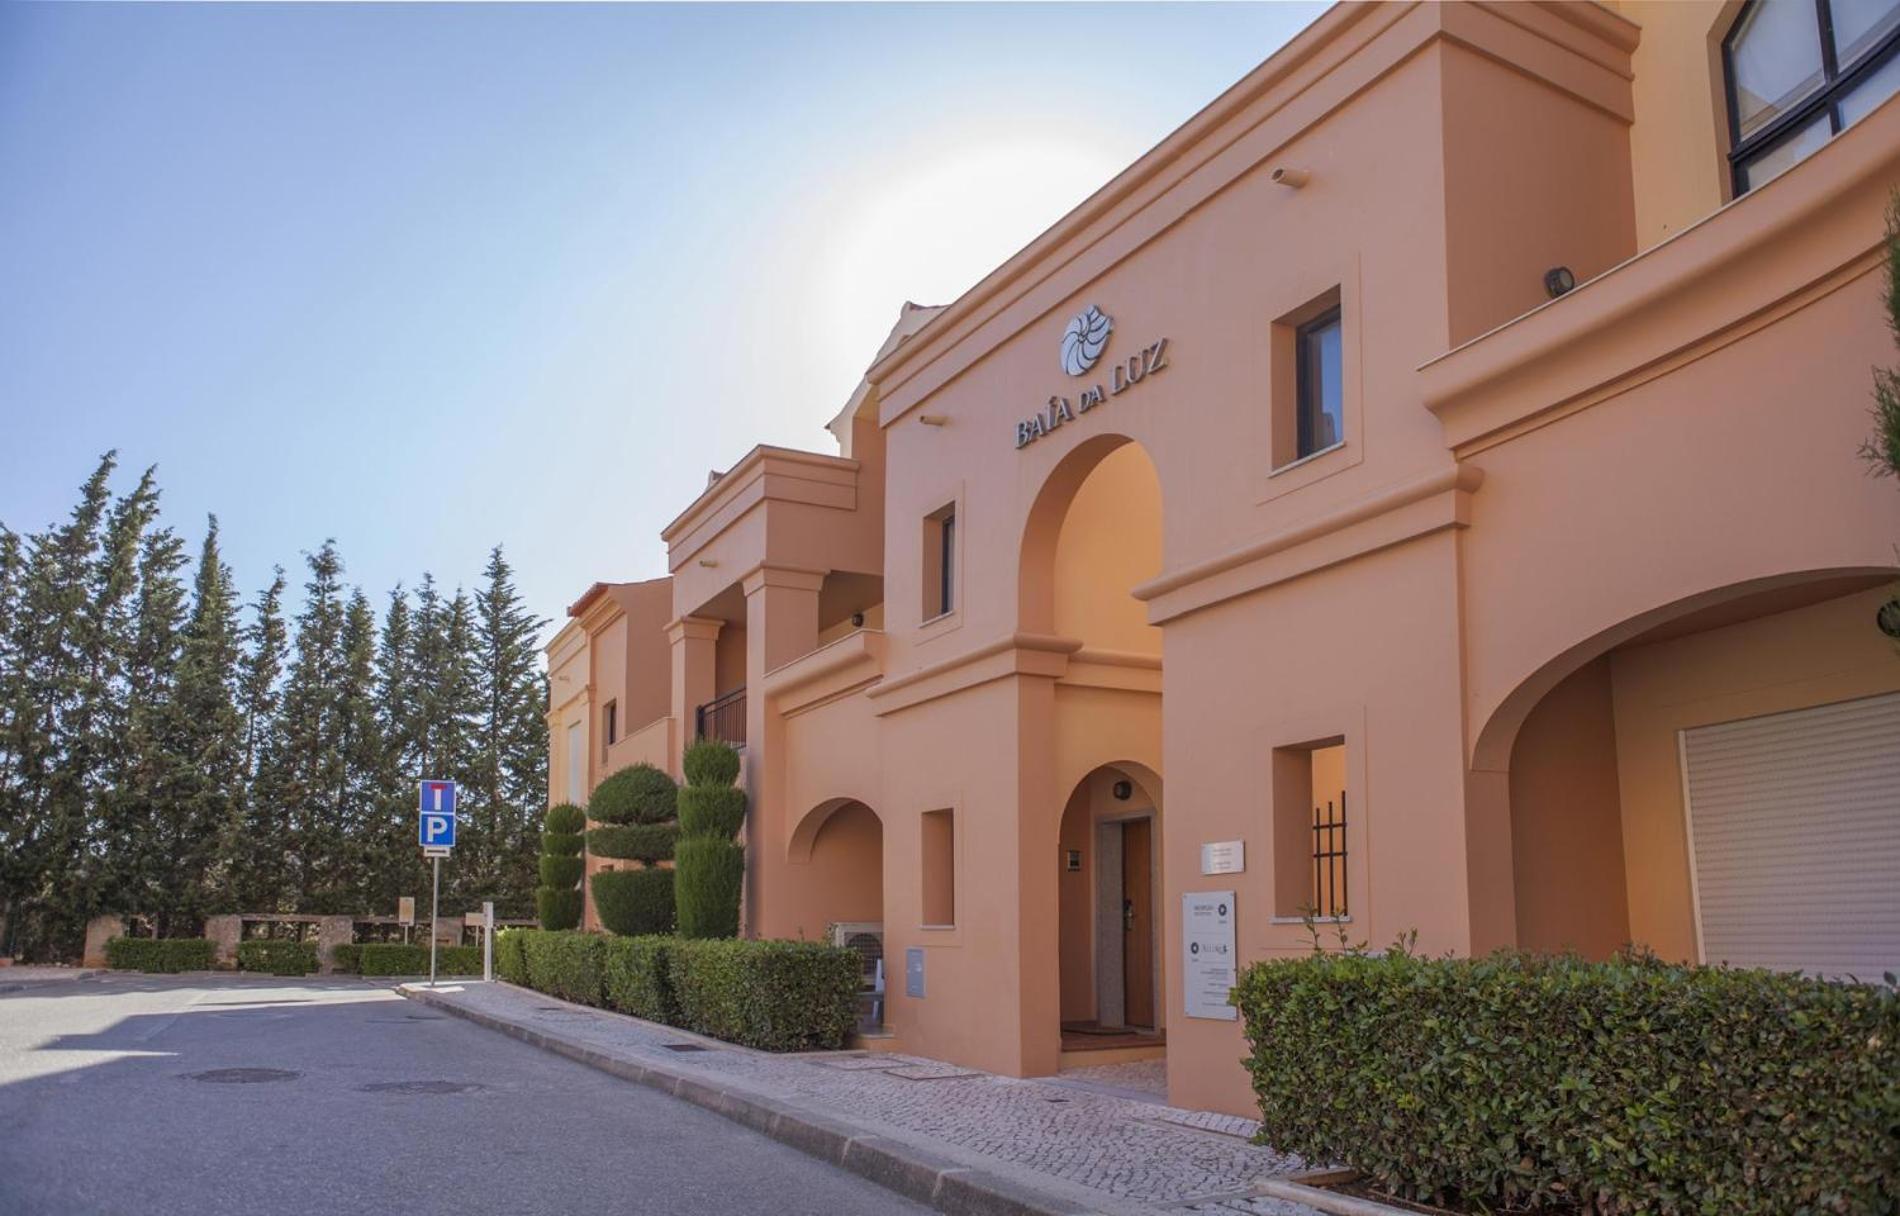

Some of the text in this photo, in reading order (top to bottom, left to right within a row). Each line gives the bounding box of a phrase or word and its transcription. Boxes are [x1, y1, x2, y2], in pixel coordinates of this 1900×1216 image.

[1015, 338, 1169, 449] BAÍA DA LUZ
[427, 816, 448, 842] P
